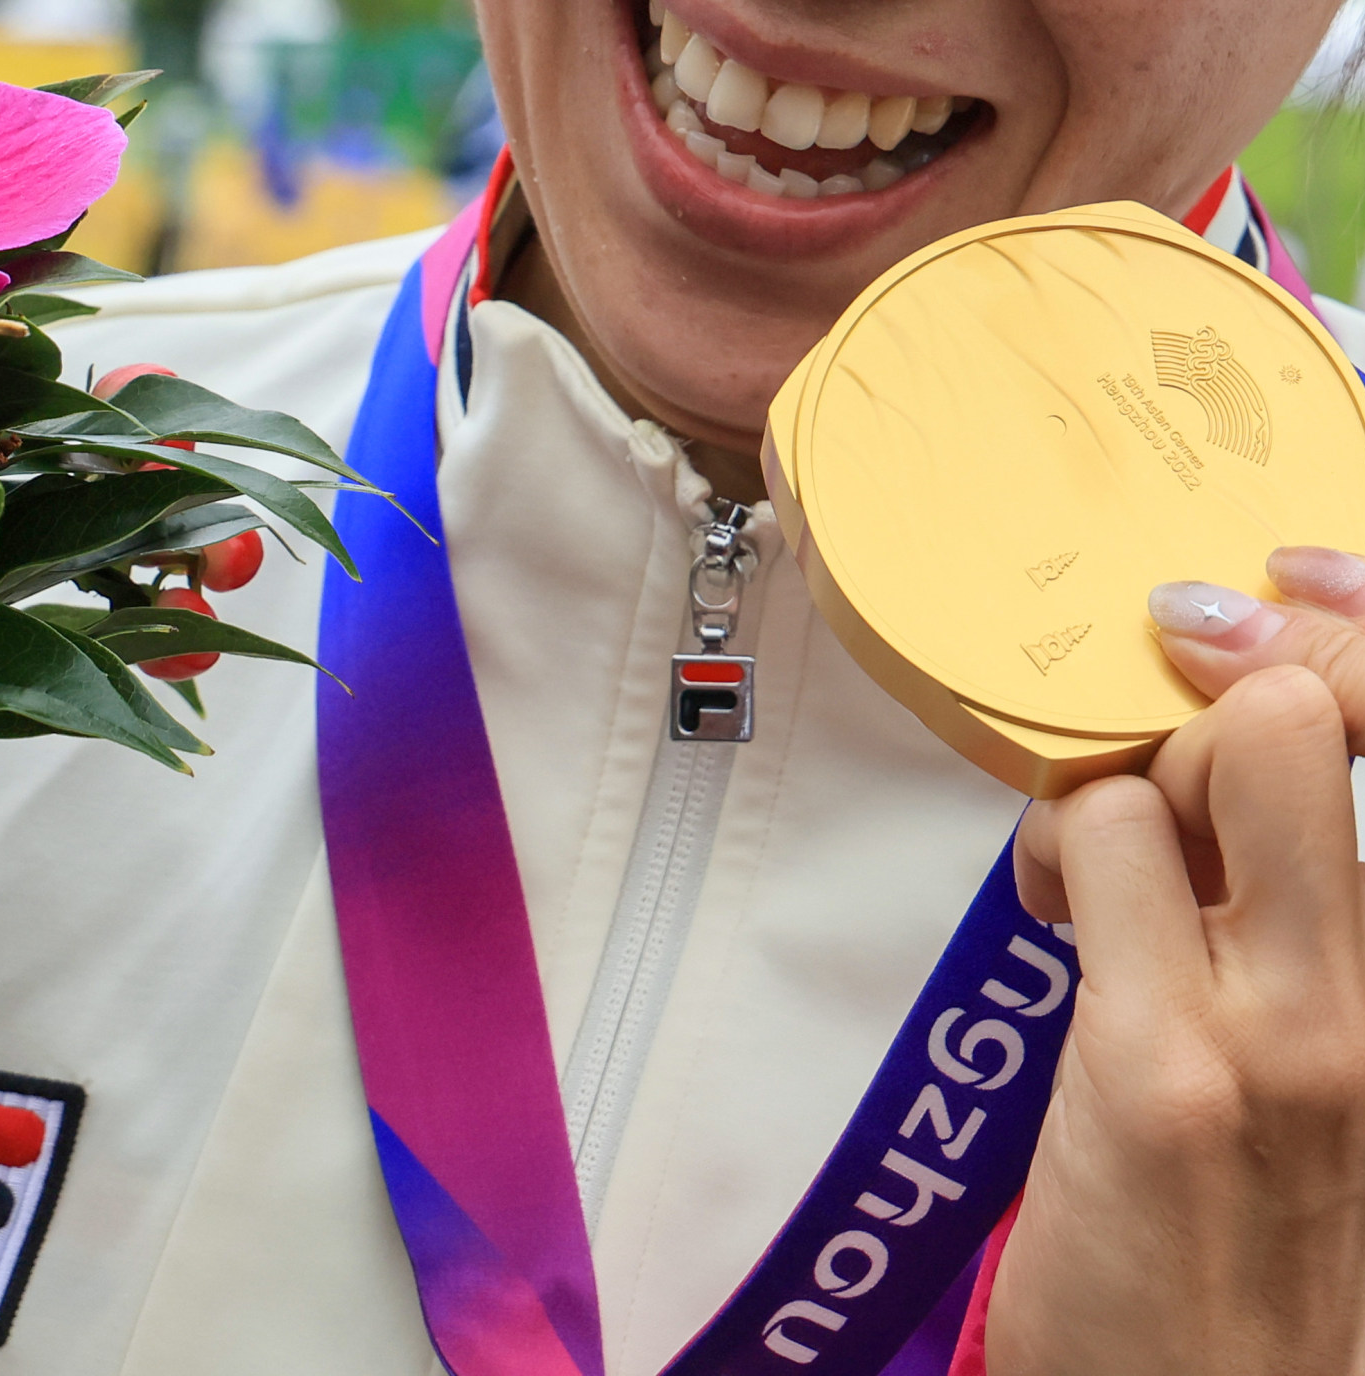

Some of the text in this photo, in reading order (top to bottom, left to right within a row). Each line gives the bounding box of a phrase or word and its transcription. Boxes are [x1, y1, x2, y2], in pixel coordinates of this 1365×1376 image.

[1097, 373, 1202, 492] Hangzhou 2022
[1121, 373, 1205, 471] 19th Asian Games
